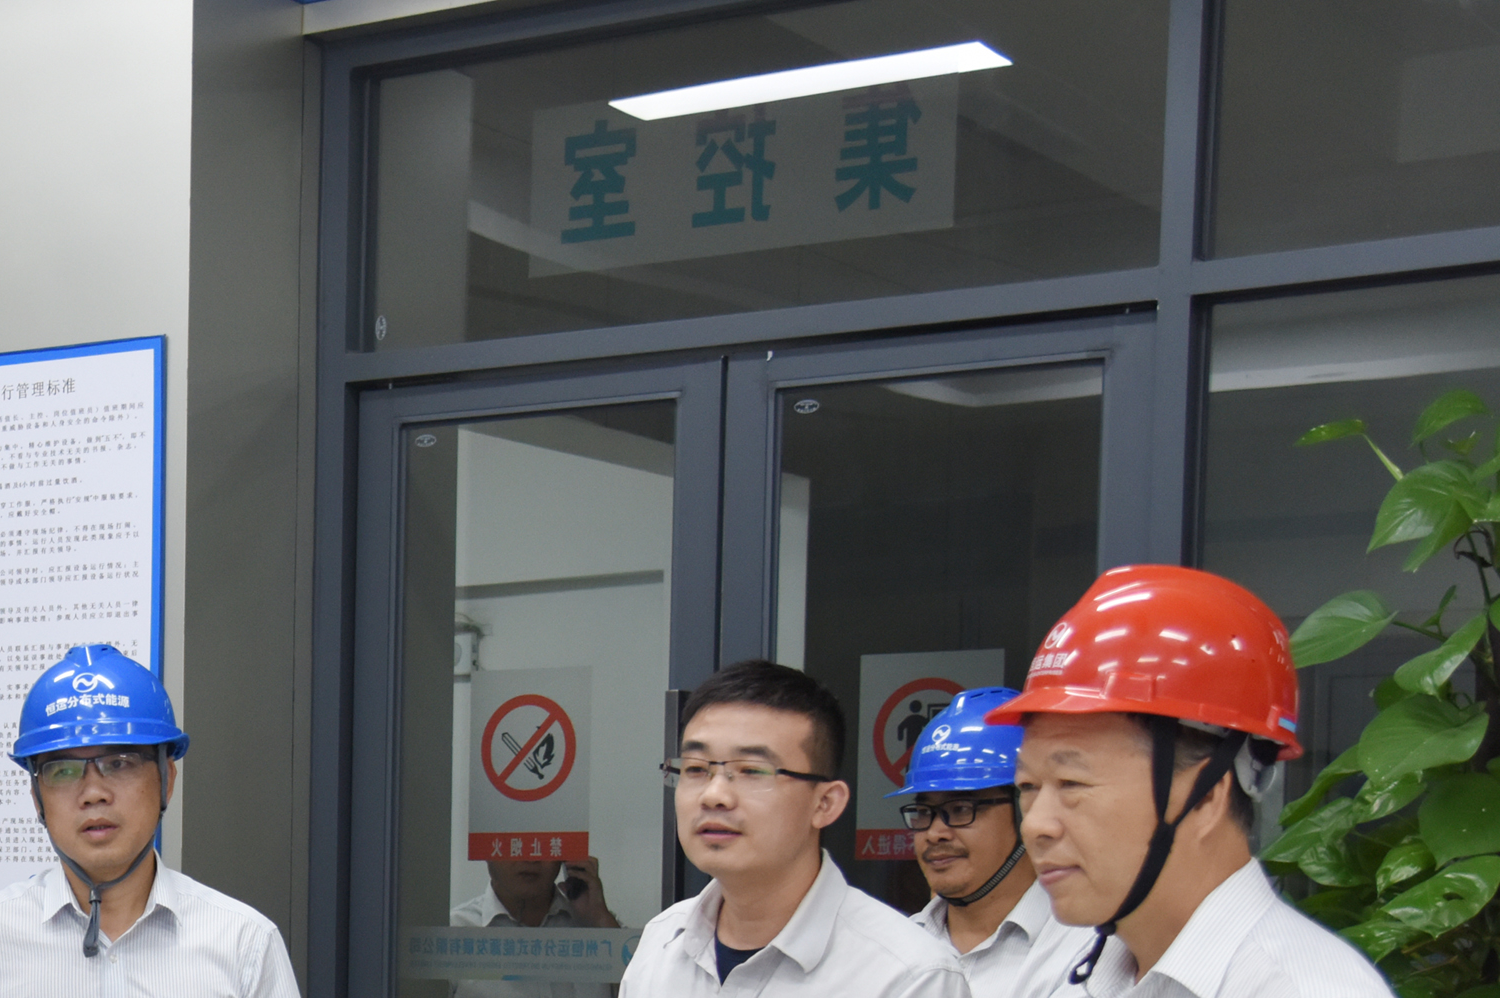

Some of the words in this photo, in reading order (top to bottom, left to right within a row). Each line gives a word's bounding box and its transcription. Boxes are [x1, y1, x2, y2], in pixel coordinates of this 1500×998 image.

[45, 693, 131, 717] 恒运分布式能源
